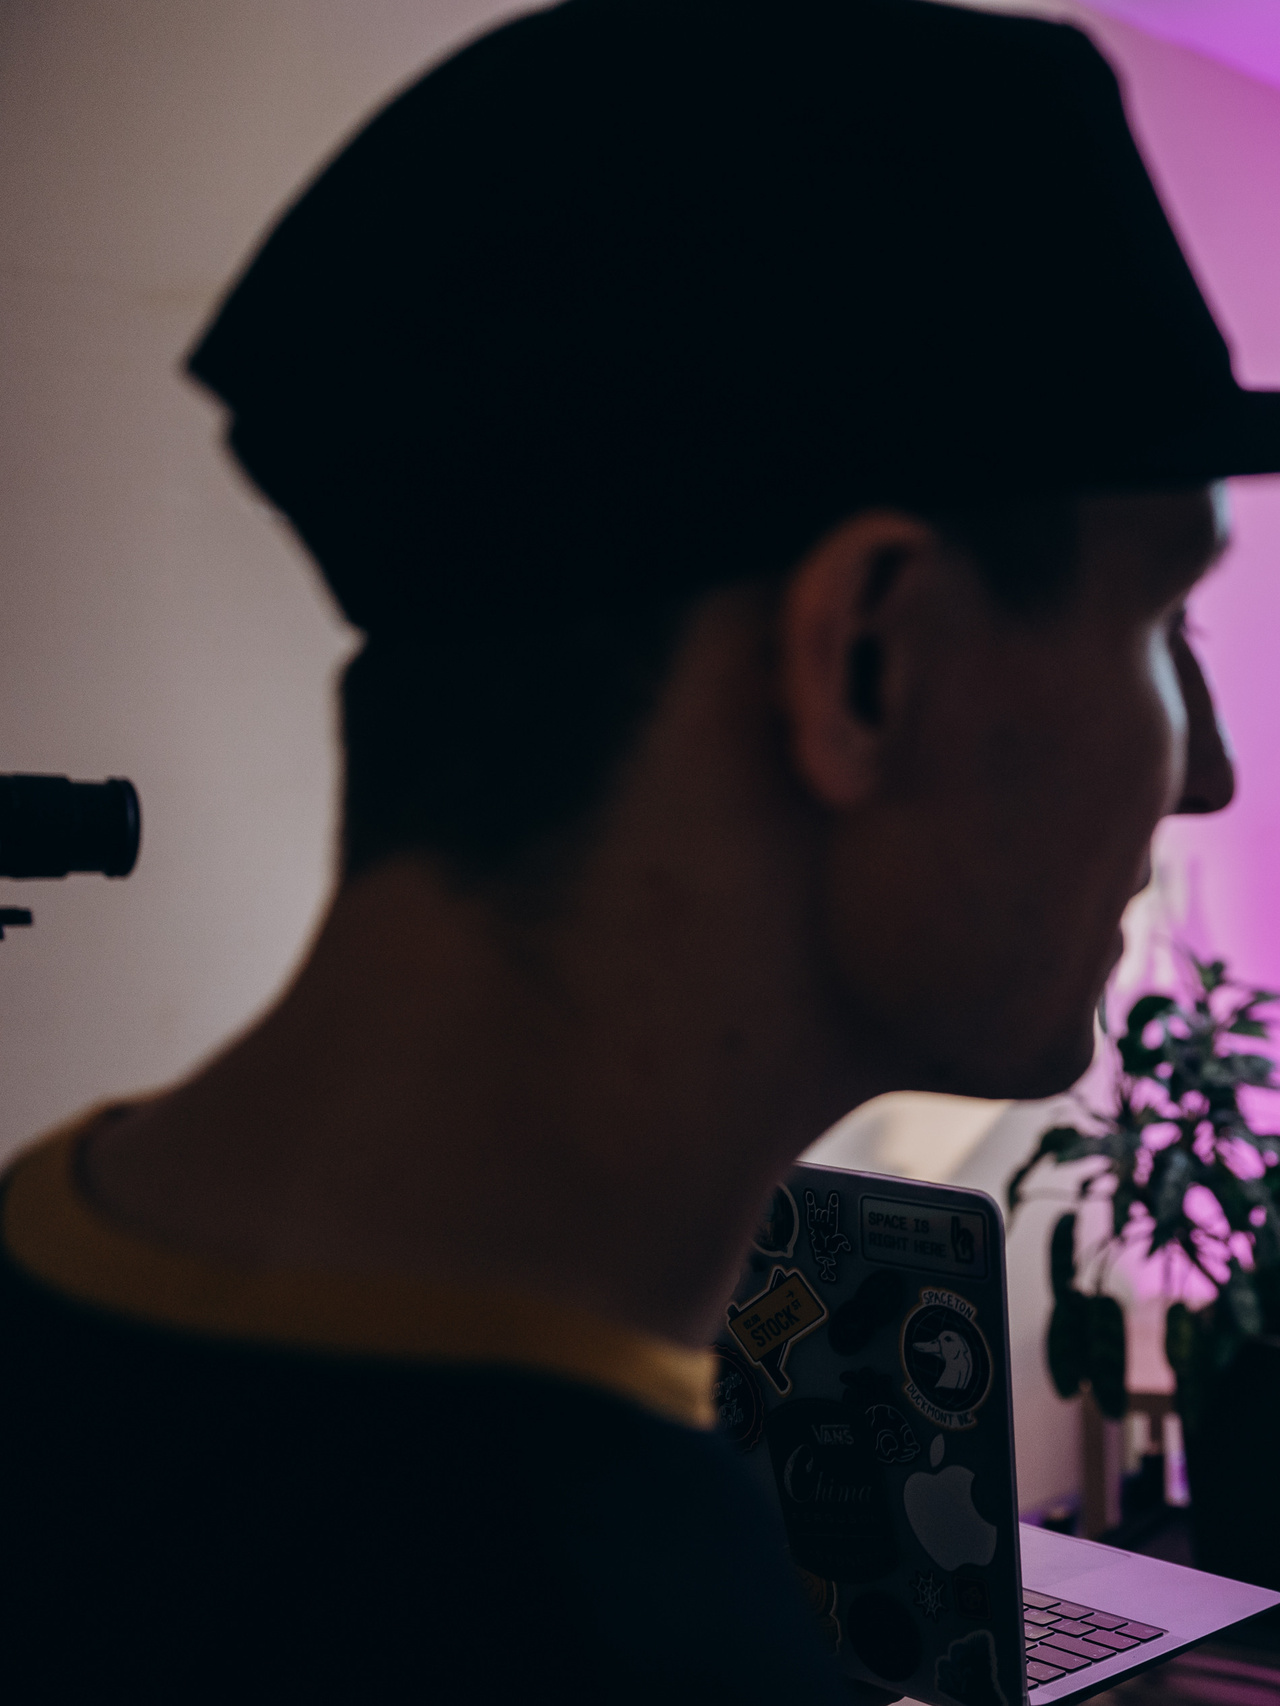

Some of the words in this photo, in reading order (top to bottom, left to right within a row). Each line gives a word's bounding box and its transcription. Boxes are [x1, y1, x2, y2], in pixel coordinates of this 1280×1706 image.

[868, 1211, 908, 1231] SPACE
[914, 1218, 930, 1234] IS
[868, 1231, 909, 1252] RIGHT
[914, 1240, 947, 1259] HERE
[922, 1291, 974, 1319] SPACETON
[750, 1304, 801, 1347] STOCK
[906, 1383, 954, 1426] DUCKMONT
[811, 1423, 855, 1446] VANS
[783, 1443, 873, 1504] Chima
